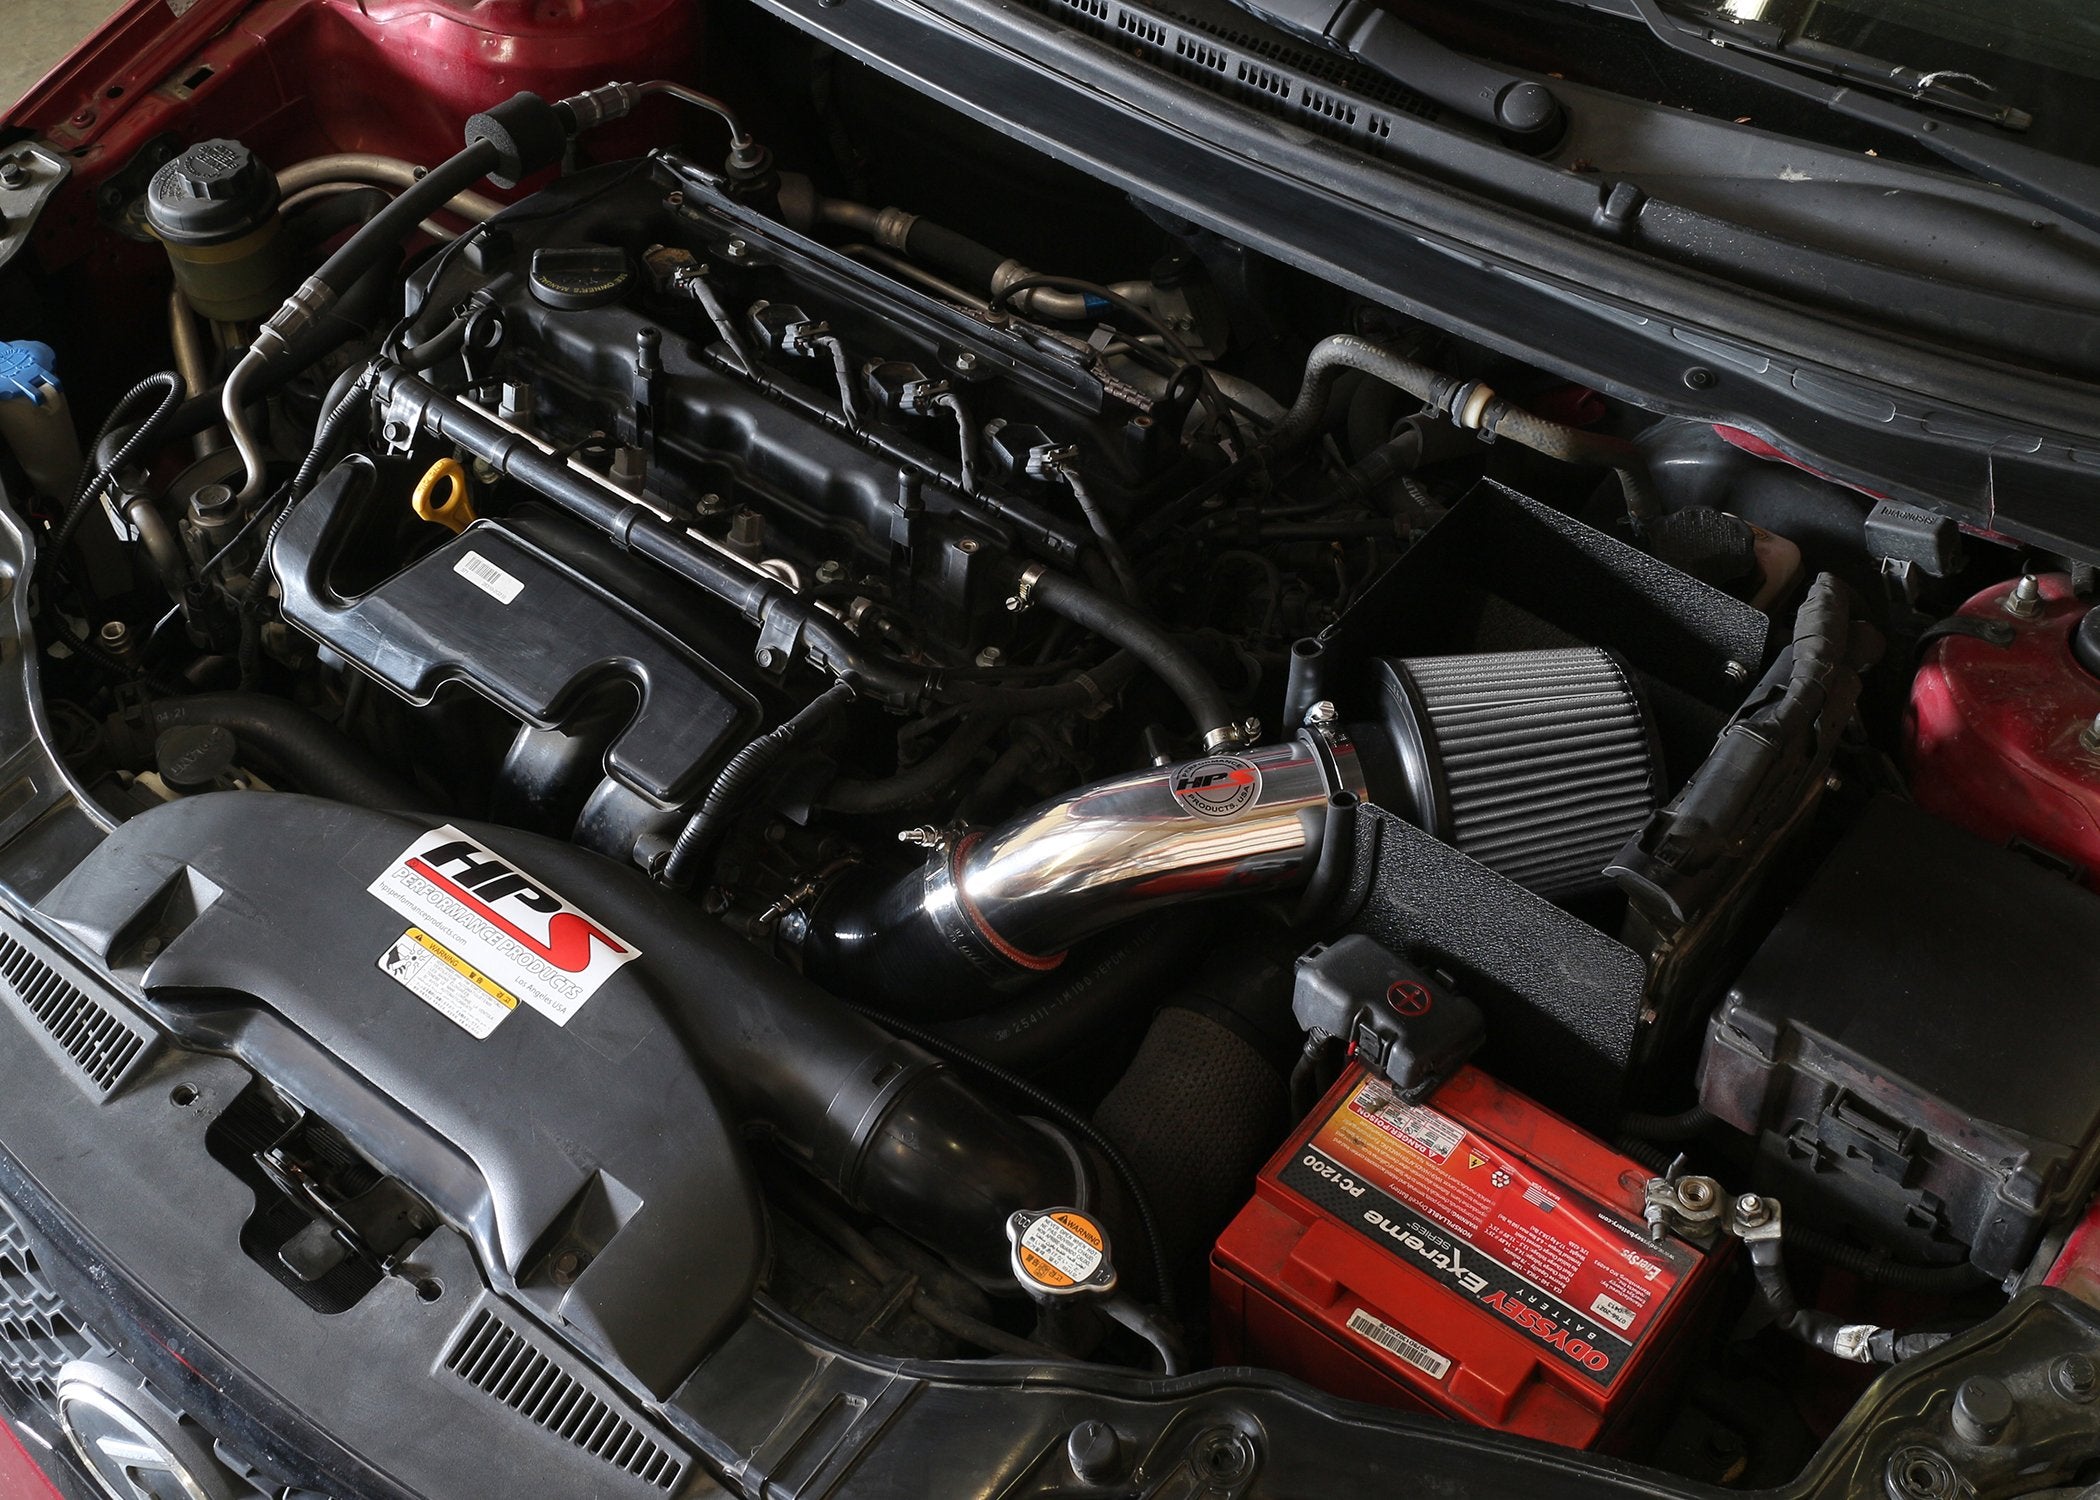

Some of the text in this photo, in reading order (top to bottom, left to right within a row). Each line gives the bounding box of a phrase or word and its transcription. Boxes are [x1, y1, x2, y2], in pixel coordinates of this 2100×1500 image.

[539, 275, 570, 292] MANUAL
[573, 281, 614, 294] OWNER'S
[1880, 505, 1934, 525] DIAGNOSIS
[1182, 759, 1243, 777] PERFORMANCE
[1175, 768, 1256, 795] HPS
[1237, 785, 1250, 803] USA
[378, 881, 467, 946] hpsperformanceproducts.com
[403, 842, 628, 969] HPS
[391, 865, 503, 947] PERFORMANCE
[495, 938, 583, 1001] PRODUCTS
[427, 942, 459, 967] WARNING
[514, 975, 567, 1014] Los Angeles USA
[1355, 1106, 1427, 1153] DANGER/POISON
[1301, 1153, 1365, 1197] PC1200
[1546, 1190, 1560, 1201] Made
[1387, 1182, 1473, 1238] NONSPILLABLE Drycell Battery
[1449, 1209, 1478, 1229] WARNING:
[1036, 1227, 1046, 1235] NON
[1040, 1222, 1048, 1230] NE
[1047, 1227, 1057, 1236] PAS
[1044, 1218, 1060, 1230] NEVER
[1059, 1228, 1073, 1240] OPEN
[1072, 1237, 1087, 1249] WHEN
[1066, 1220, 1101, 1246] WARNING
[1513, 1230, 1527, 1240] Limit
[1596, 1212, 1675, 1260] www.odysseybattery.com
[1525, 1237, 1543, 1250] Current
[1549, 1235, 1557, 1243] kg
[1502, 1246, 1521, 1261] minutes
[1542, 1246, 1558, 1259] Charge
[1547, 1242, 1563, 1254] Torque
[1568, 1247, 1586, 1260] Weight
[1510, 1259, 1523, 1270] 1200
[1546, 1257, 1563, 1270] Charge
[1557, 1256, 1572, 1267] Initial
[1561, 1251, 1582, 1266] Terminal
[1620, 1248, 1661, 1281] EnerSys
[1094, 1268, 1110, 1284] 1.1
[1529, 1262, 1550, 1278] Capacity
[1541, 1262, 1559, 1275] Charge
[1557, 1271, 1571, 1282] Cyclic
[1561, 1266, 1574, 1277] Float
[1593, 1259, 1652, 1295] Warrensburg, MO 64093
[1362, 1207, 1609, 1370] ODYSSEY Extreme
[1547, 1274, 1567, 1288] Reserve
[1552, 1285, 1563, 1294] CCA
[1607, 1278, 1646, 1304] EnerSys Energy
[1607, 1284, 1643, 1308] Manufactured
[1515, 1288, 1597, 1340] BATTERY
